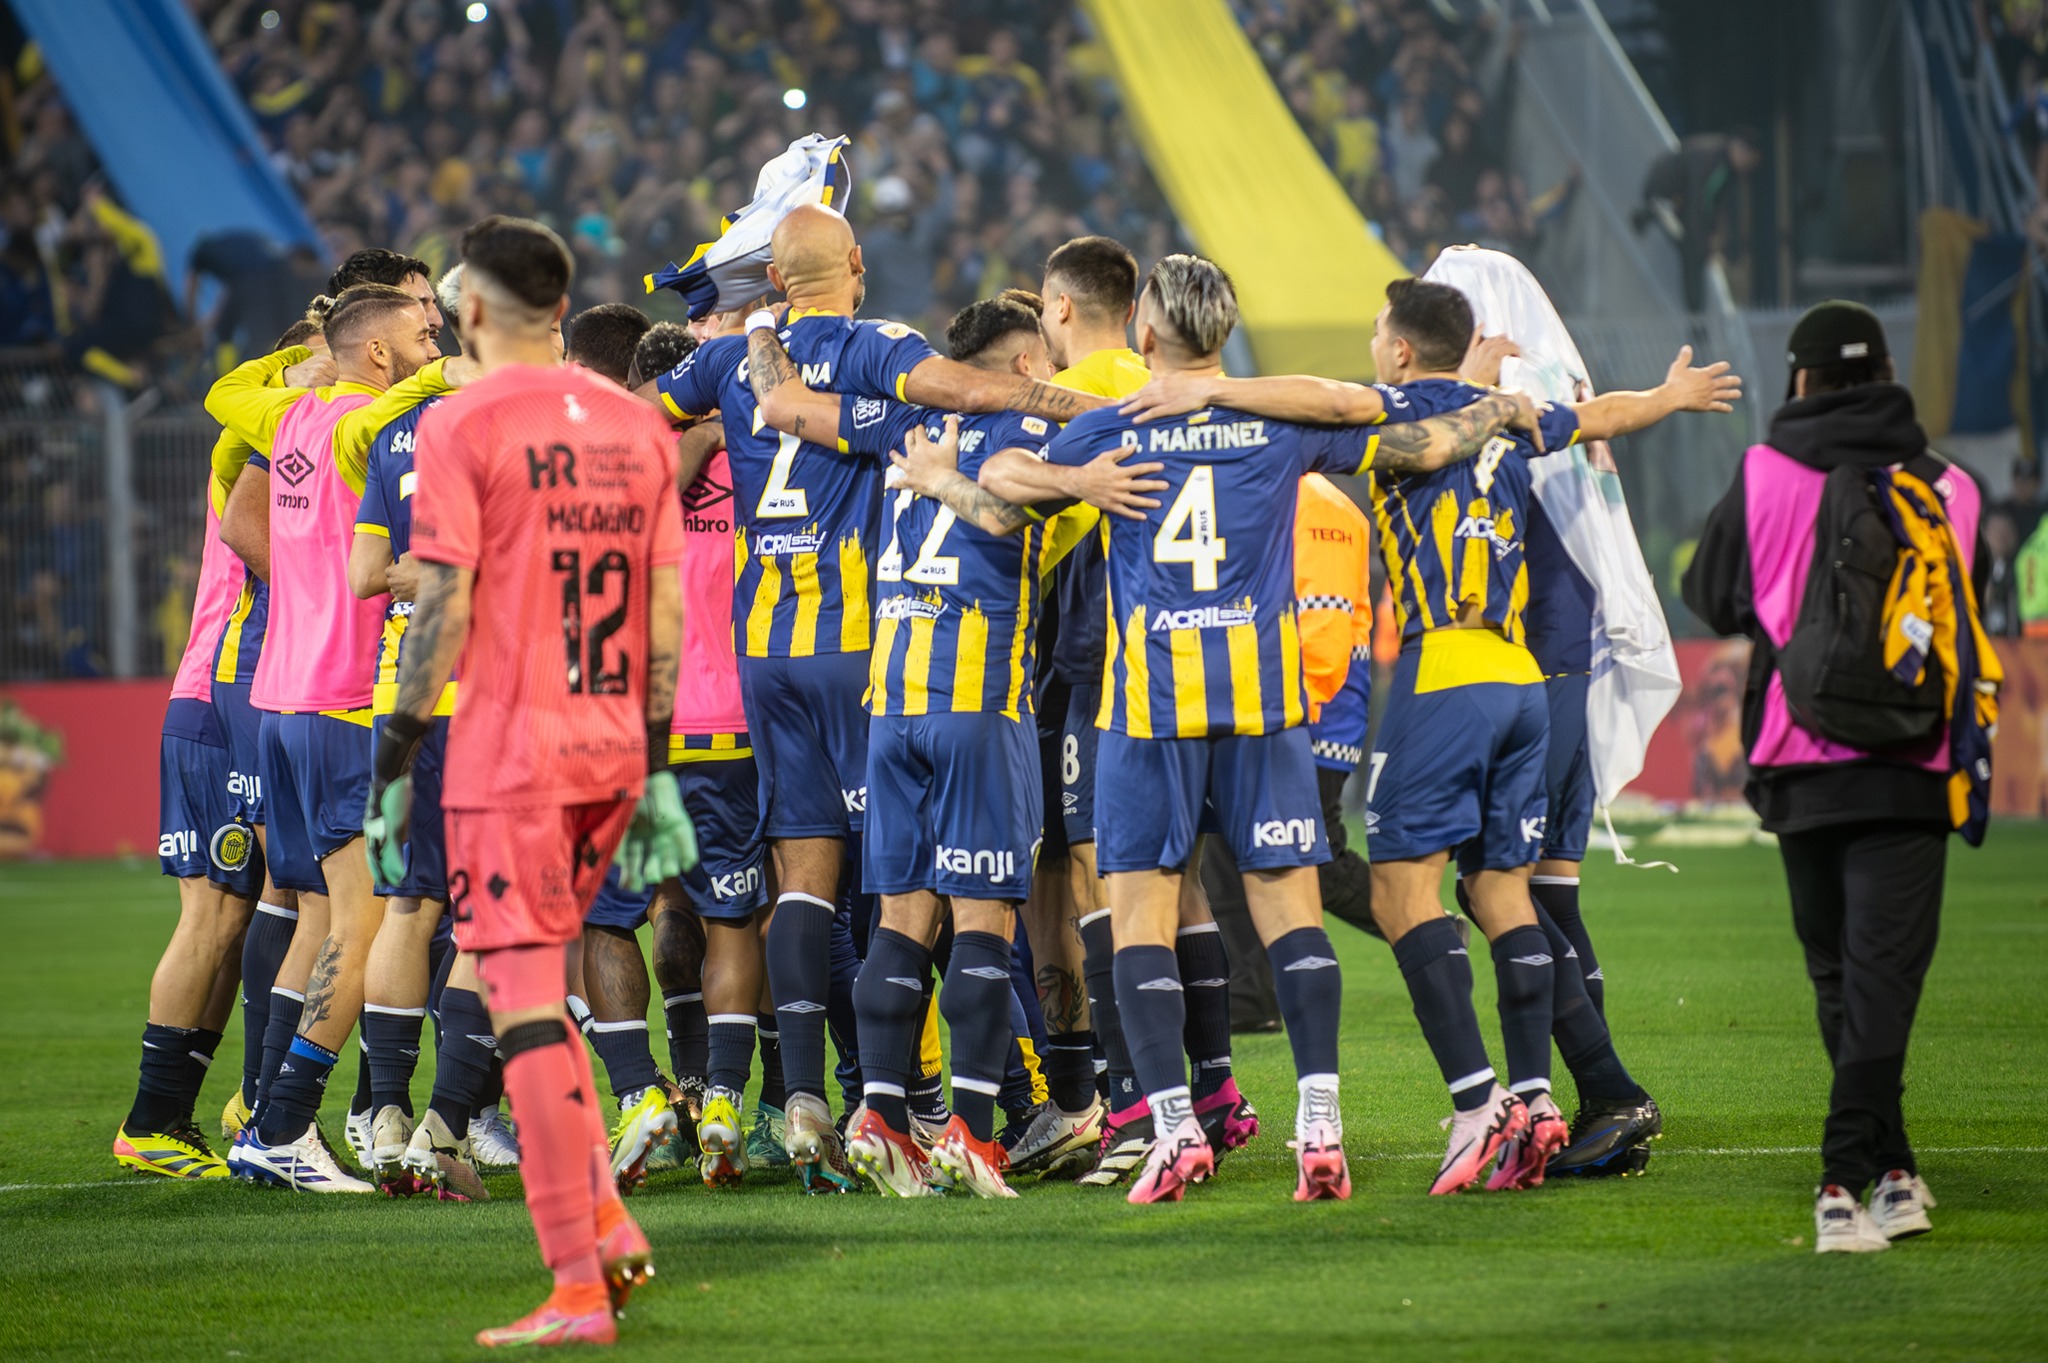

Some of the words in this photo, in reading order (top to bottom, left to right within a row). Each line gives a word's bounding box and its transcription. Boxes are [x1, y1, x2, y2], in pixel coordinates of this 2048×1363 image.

[1121, 430, 1143, 453] D.
[1150, 421, 1269, 452] MARTINEZ
[526, 443, 577, 489] HR
[752, 405, 809, 518] 2
[276, 492, 310, 510] umbro
[780, 499, 796, 508] RUS
[684, 514, 729, 533] mbro
[1153, 465, 1226, 592] 4
[1308, 527, 1353, 546] TECH
[930, 566, 947, 575] RUS
[552, 550, 630, 694] 12
[1151, 606, 1247, 632] ACRIL
[226, 771, 261, 805] anji
[158, 830, 197, 861] anji
[1253, 817, 1315, 852] kanji
[936, 844, 1014, 883] kanji
[710, 866, 763, 900] kan
